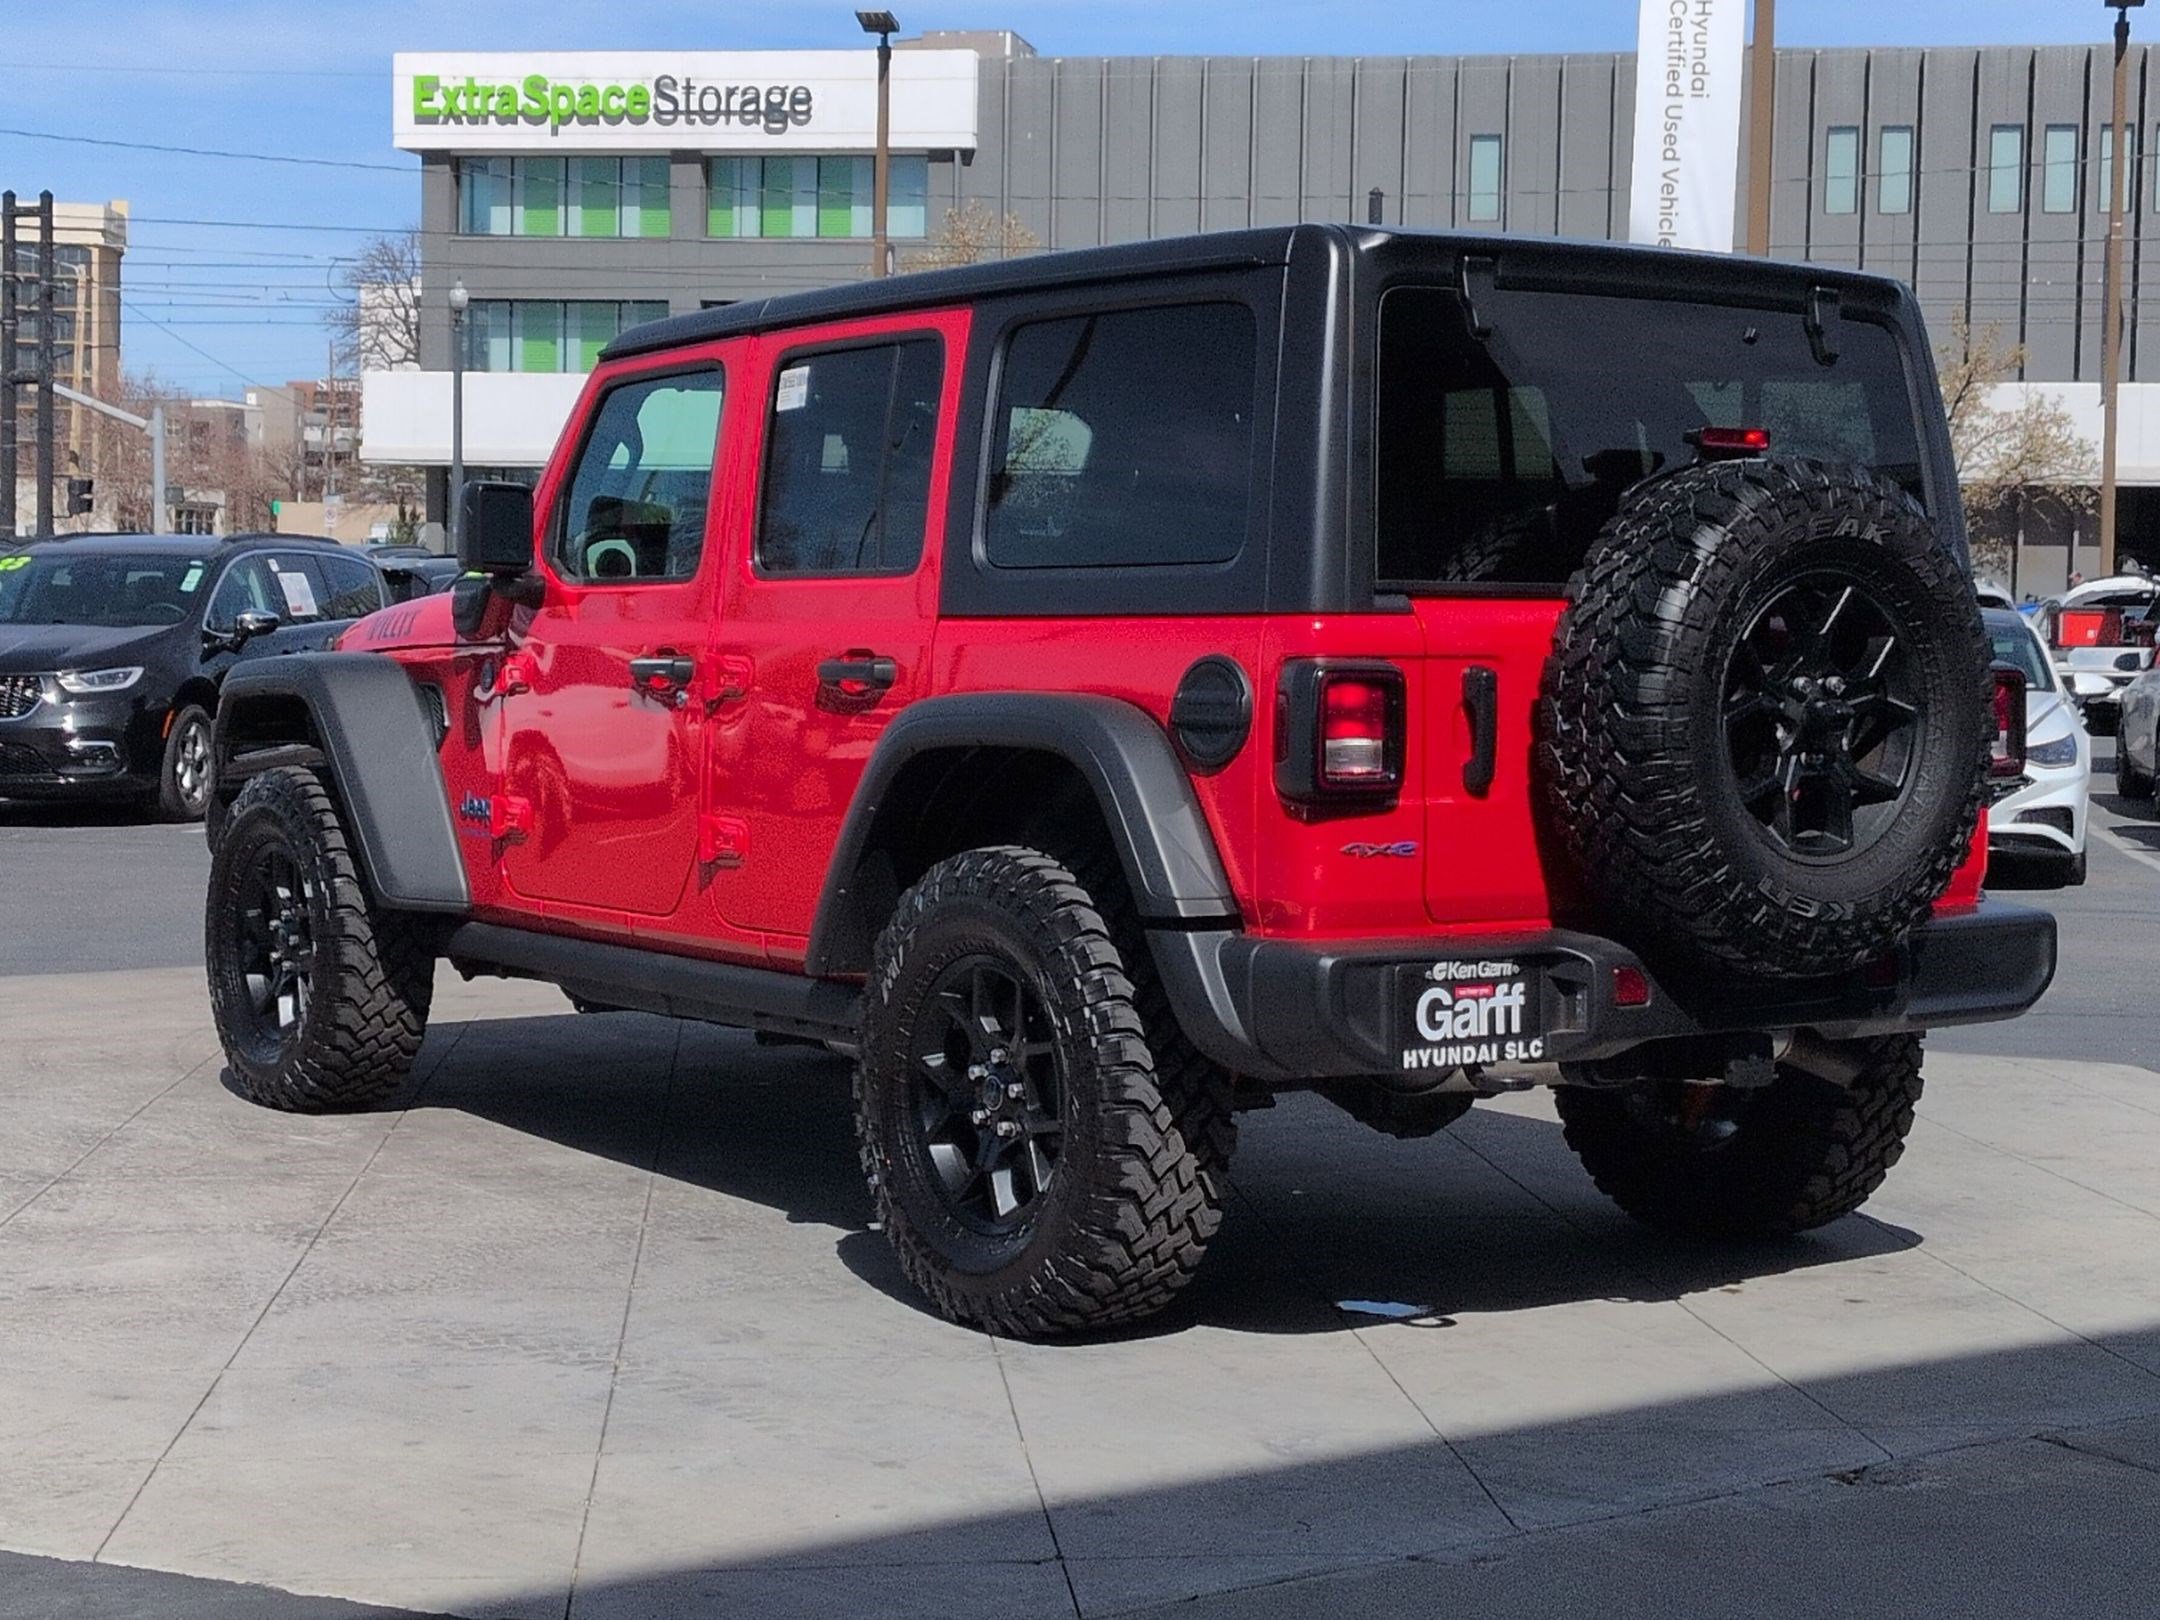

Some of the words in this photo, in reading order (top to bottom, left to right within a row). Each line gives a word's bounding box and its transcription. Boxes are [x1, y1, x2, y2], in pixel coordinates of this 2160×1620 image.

[1665, 0, 1688, 97] Certified
[1690, 0, 1713, 98] Hyundai
[1662, 104, 1683, 161] Used
[1416, 982, 1525, 1041] Garff
[1403, 1043, 1498, 1069] HYUNDAI
[1504, 1038, 1544, 1060] SLC
